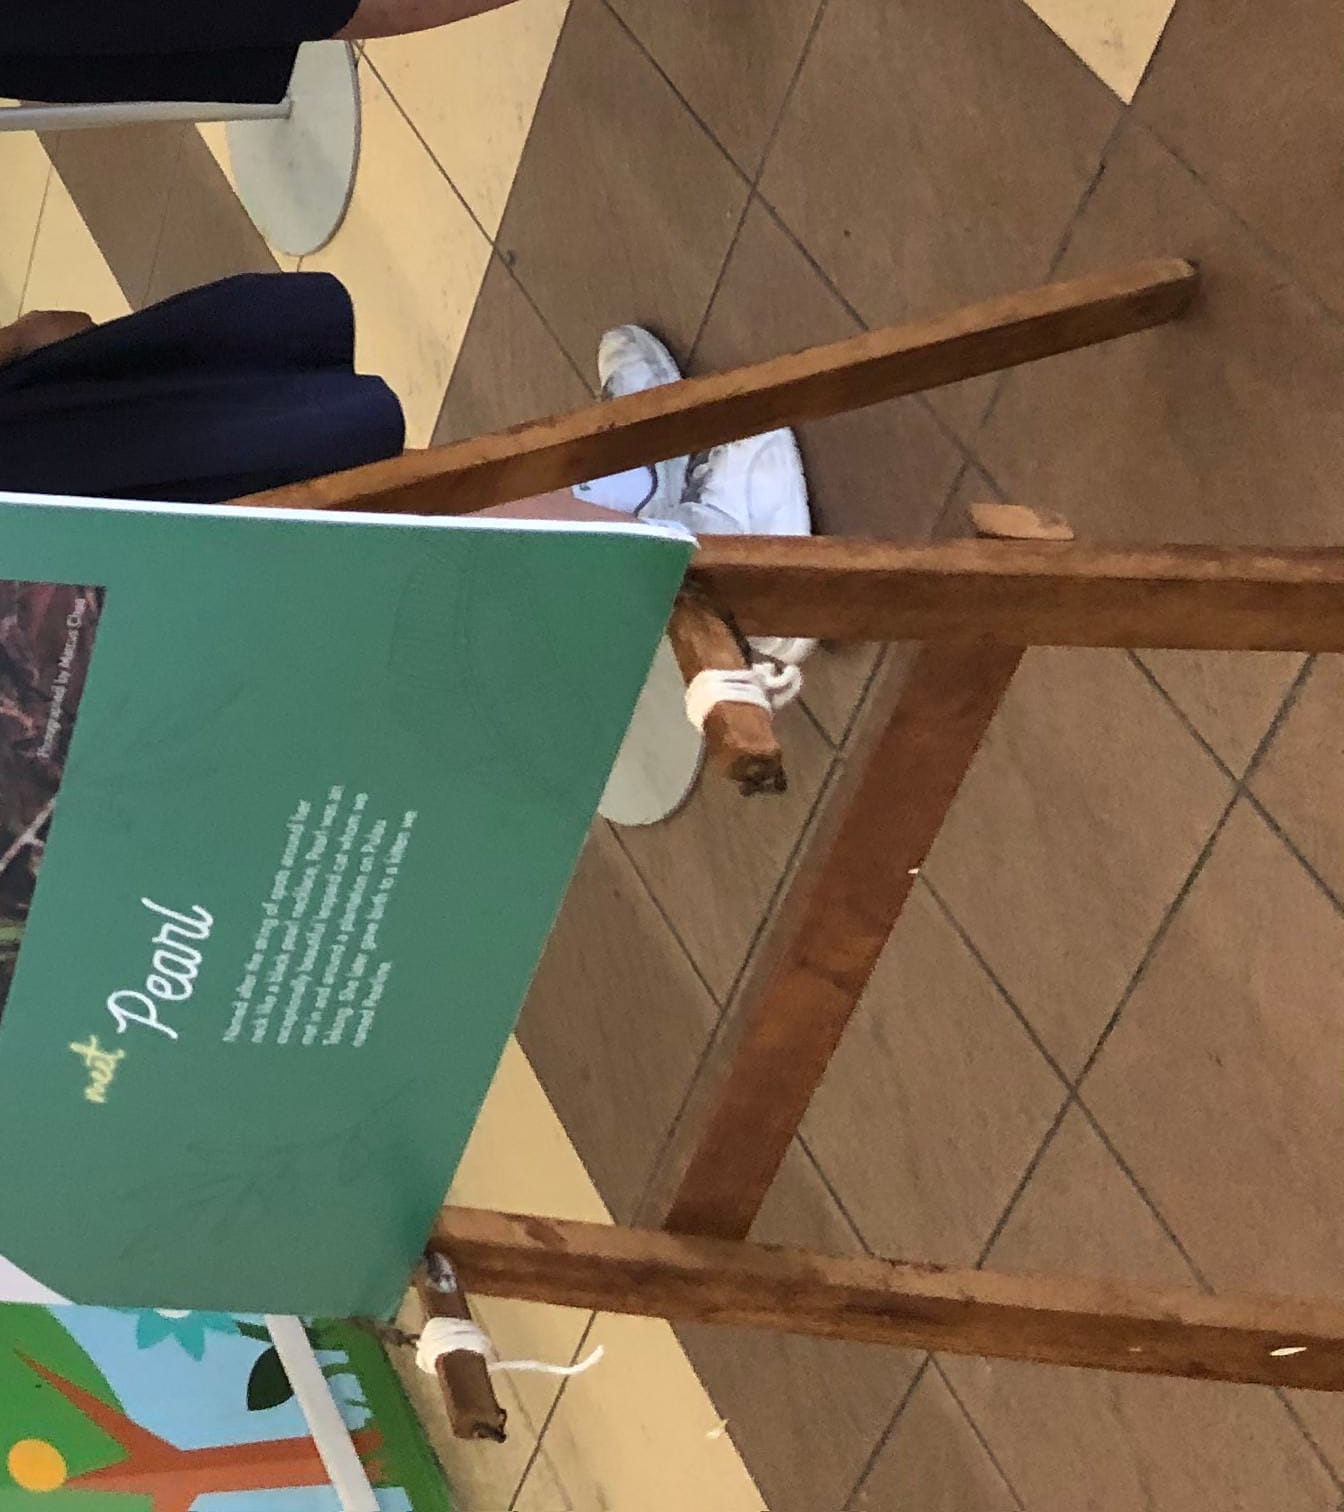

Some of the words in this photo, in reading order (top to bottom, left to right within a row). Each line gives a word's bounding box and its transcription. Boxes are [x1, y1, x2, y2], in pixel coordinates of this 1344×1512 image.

[58, 630, 79, 668] Marcus
[54, 671, 70, 683] by
[289, 800, 311, 821] her
[281, 824, 304, 867] around
[262, 902, 279, 915] of
[265, 954, 290, 982] black
[305, 830, 328, 860] Pearl
[313, 874, 342, 919] leopard
[322, 945, 346, 984] around
[360, 820, 387, 852] Pulau
[361, 923, 378, 950] gave
[107, 897, 214, 1041] Pearl
[245, 954, 264, 971] the
[236, 974, 256, 999] after
[222, 1002, 249, 1042] Named
[69, 1035, 125, 1103] meet
